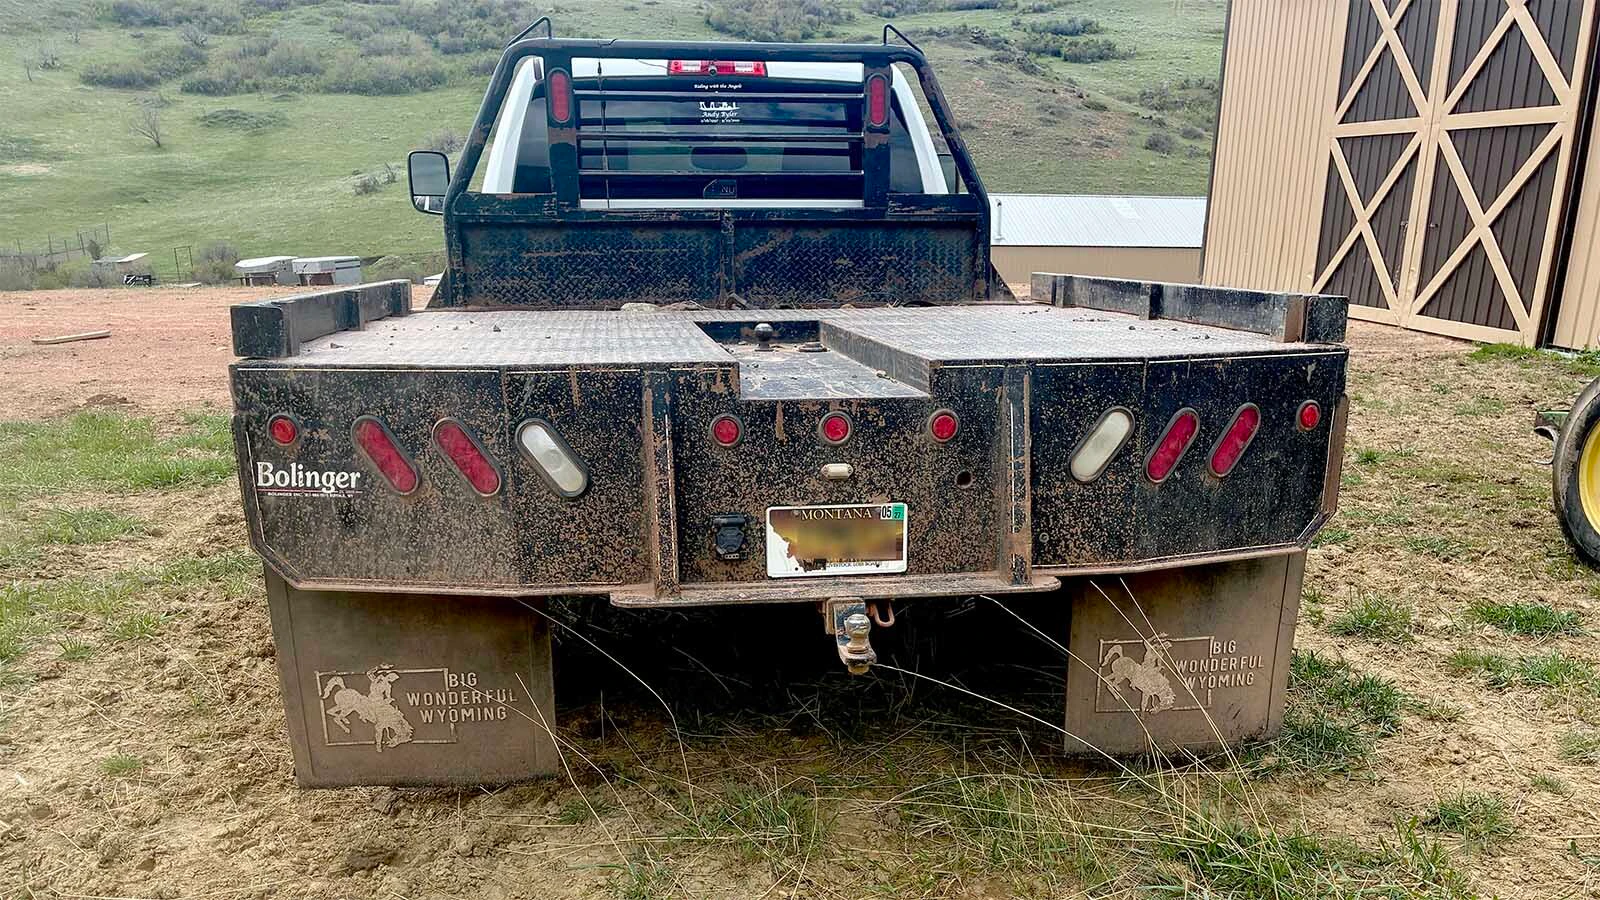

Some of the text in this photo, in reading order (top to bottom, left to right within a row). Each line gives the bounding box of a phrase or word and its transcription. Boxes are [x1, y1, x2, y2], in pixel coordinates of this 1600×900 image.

[256, 461, 361, 494] Bolinger
[801, 507, 872, 521] MONTANA
[881, 505, 892, 519] 05
[1213, 640, 1236, 655] BIG
[1176, 655, 1265, 673] WONDERFUL
[449, 672, 477, 688] BIG
[1184, 672, 1254, 690] WYOMING
[406, 688, 518, 707] WONDERFUL
[419, 706, 507, 723] WYOMING
